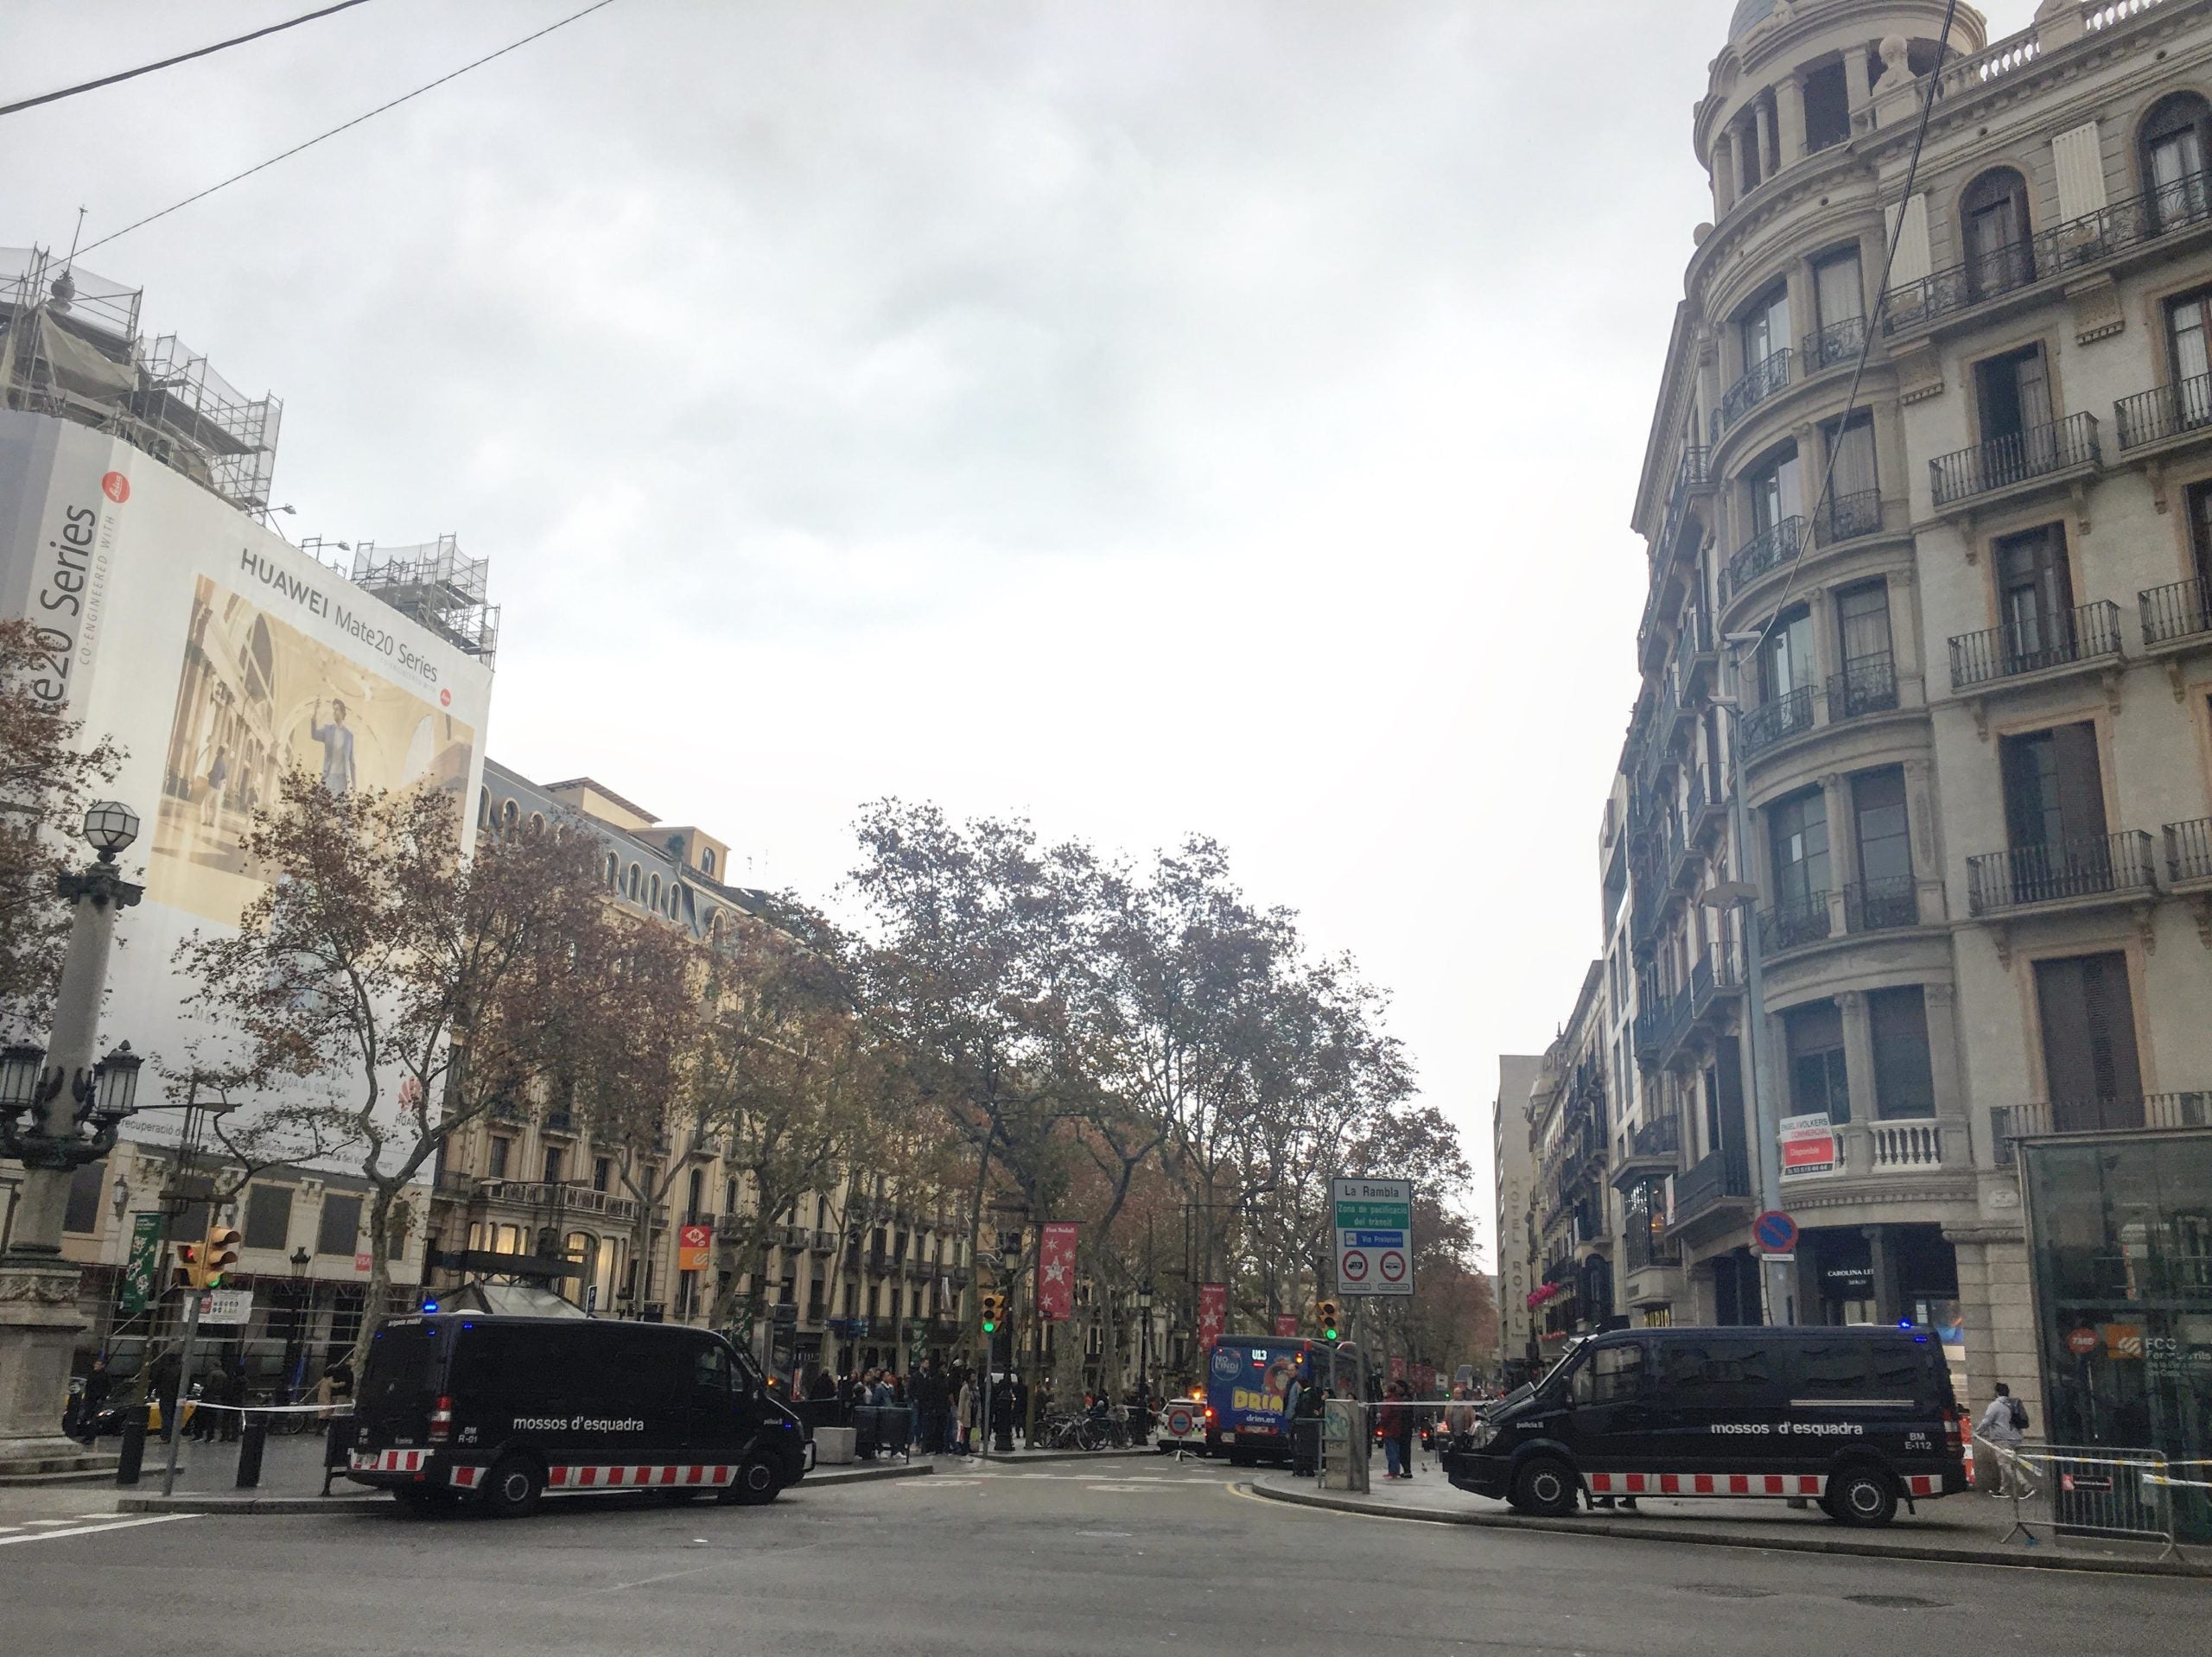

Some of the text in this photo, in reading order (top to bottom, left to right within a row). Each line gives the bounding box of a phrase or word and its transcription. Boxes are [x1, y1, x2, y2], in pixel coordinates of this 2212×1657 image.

[40, 505, 95, 617] Series
[79, 516, 116, 665] CO-ENGINEERED WITH
[240, 548, 437, 682] HUAWEI Mate20 Series
[121, 1118, 174, 1135] recuperació
[1344, 1185, 1400, 1197] La Rambla
[1338, 1204, 1356, 1213] Zona
[1358, 1204, 1367, 1214] de
[1512, 1260, 1524, 1330] ROYAL
[513, 1416, 645, 1433] mossos d'esquadra
[1246, 1414, 1276, 1424] drim.es
[464, 1426, 477, 1435] BM
[1711, 1423, 1770, 1434] mossos
[458, 1435, 478, 1444] R-01
[1909, 1432, 1926, 1441] BM
[1904, 1441, 1932, 1450] E-112
